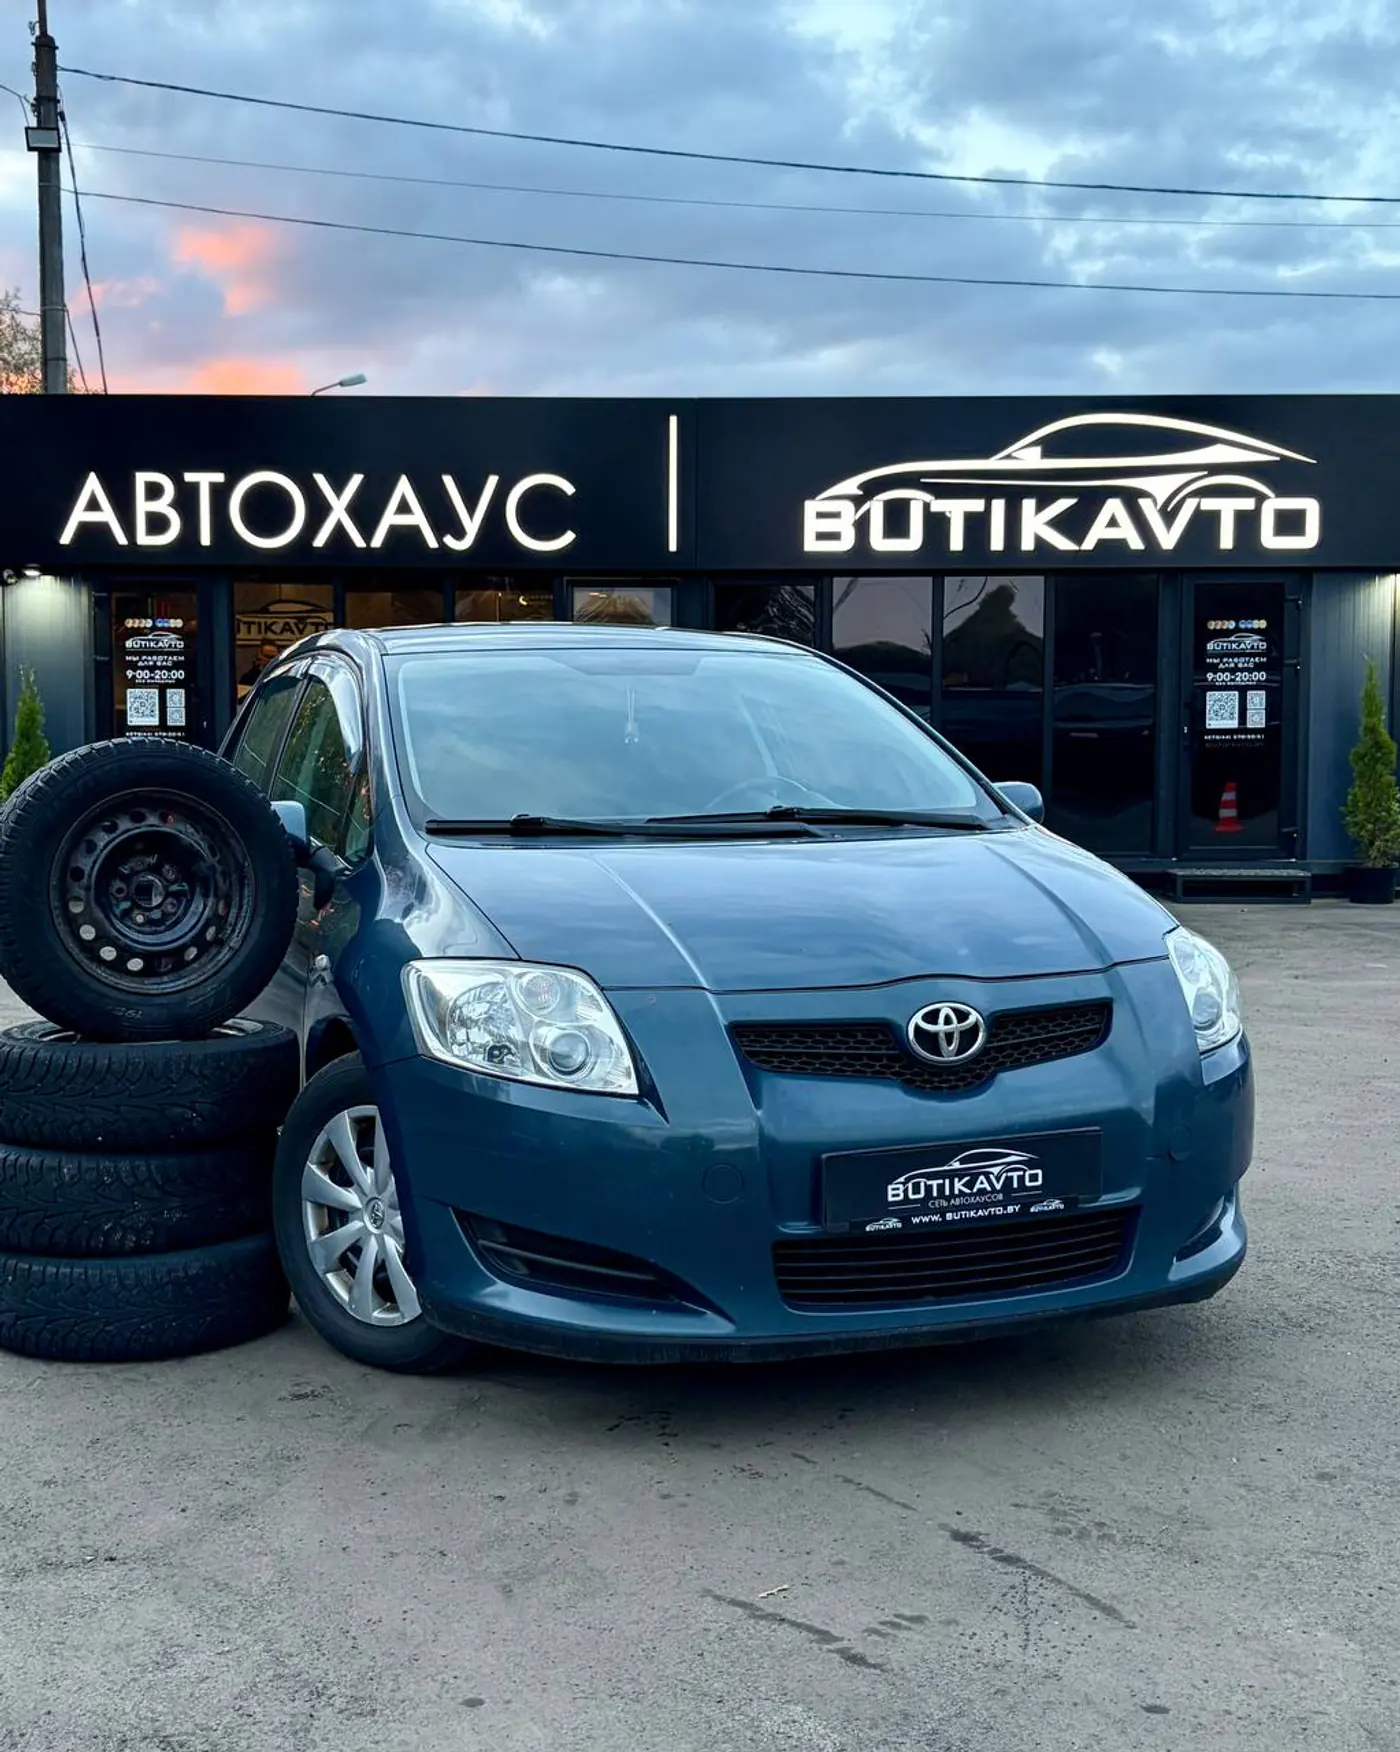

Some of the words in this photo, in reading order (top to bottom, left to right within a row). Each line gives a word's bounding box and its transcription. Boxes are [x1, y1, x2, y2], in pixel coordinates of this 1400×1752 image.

[58, 470, 578, 553] АВТОХАУС
[803, 496, 1321, 552] BUTIKAVTO
[1206, 641, 1267, 650] BUTIKAVTO
[126, 670, 185, 679] 9:00-20:00
[1206, 671, 1267, 682] 9:00-20:00
[887, 1168, 1043, 1202] BUTIKAVTO
[911, 1213, 943, 1224] WWW.
[945, 1204, 1021, 1221] BUTIKAVTO.BY
